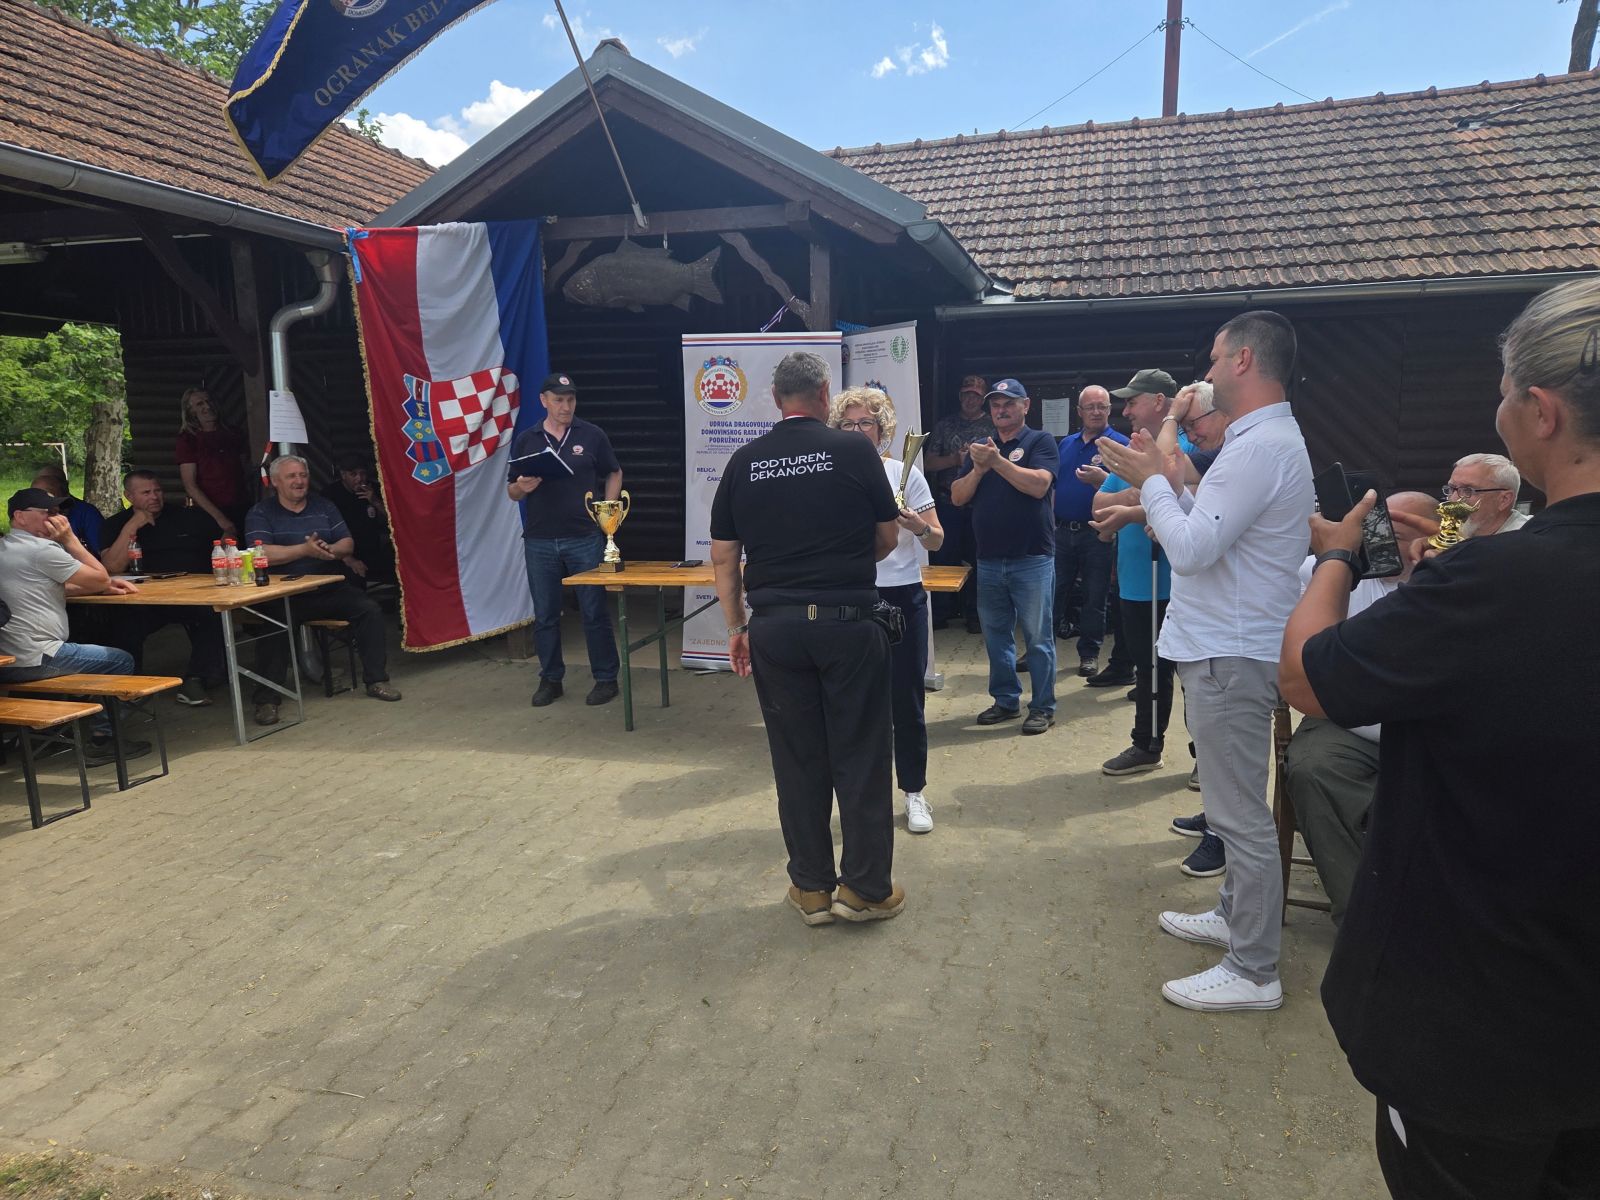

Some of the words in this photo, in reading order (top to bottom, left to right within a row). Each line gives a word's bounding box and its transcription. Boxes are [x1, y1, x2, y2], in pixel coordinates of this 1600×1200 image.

[314, 23, 407, 106] OGRANAK
[403, 0, 448, 33] BEL
[750, 451, 832, 472] PODTUREN-
[750, 462, 834, 482] DEKANOVEC
